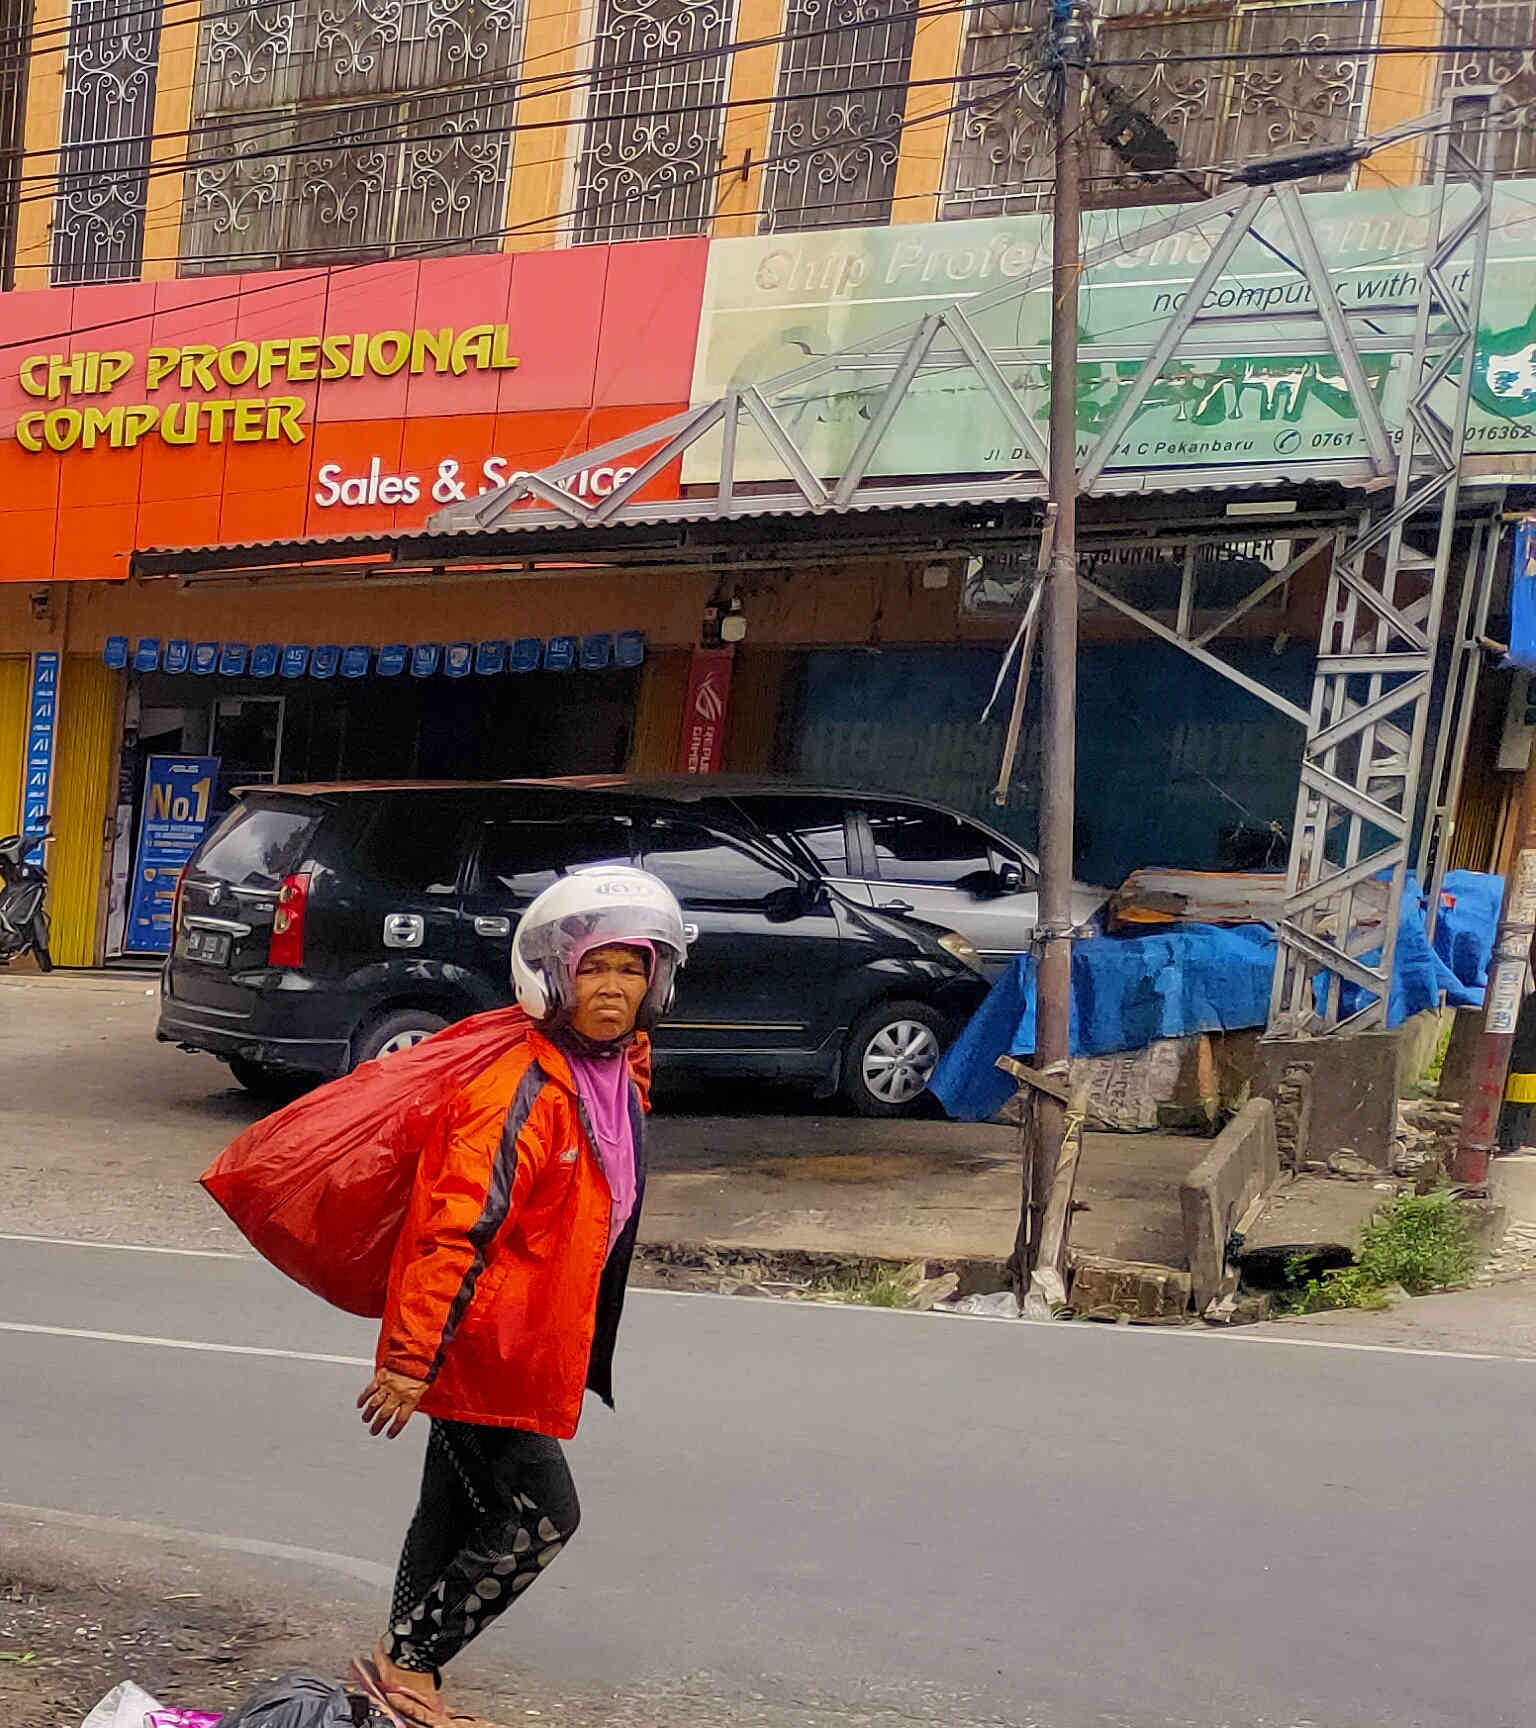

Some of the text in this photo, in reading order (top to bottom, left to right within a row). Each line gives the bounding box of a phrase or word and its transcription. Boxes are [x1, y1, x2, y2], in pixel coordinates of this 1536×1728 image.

[17, 322, 521, 400] CHIP PROFESIONAL
[14, 396, 307, 453] COMPUTER
[1154, 439, 1255, 455] Pekanbaru
[1311, 432, 1354, 448] 0761
[315, 456, 421, 508] Sales
[431, 459, 466, 503] &
[147, 777, 212, 823] No.1
